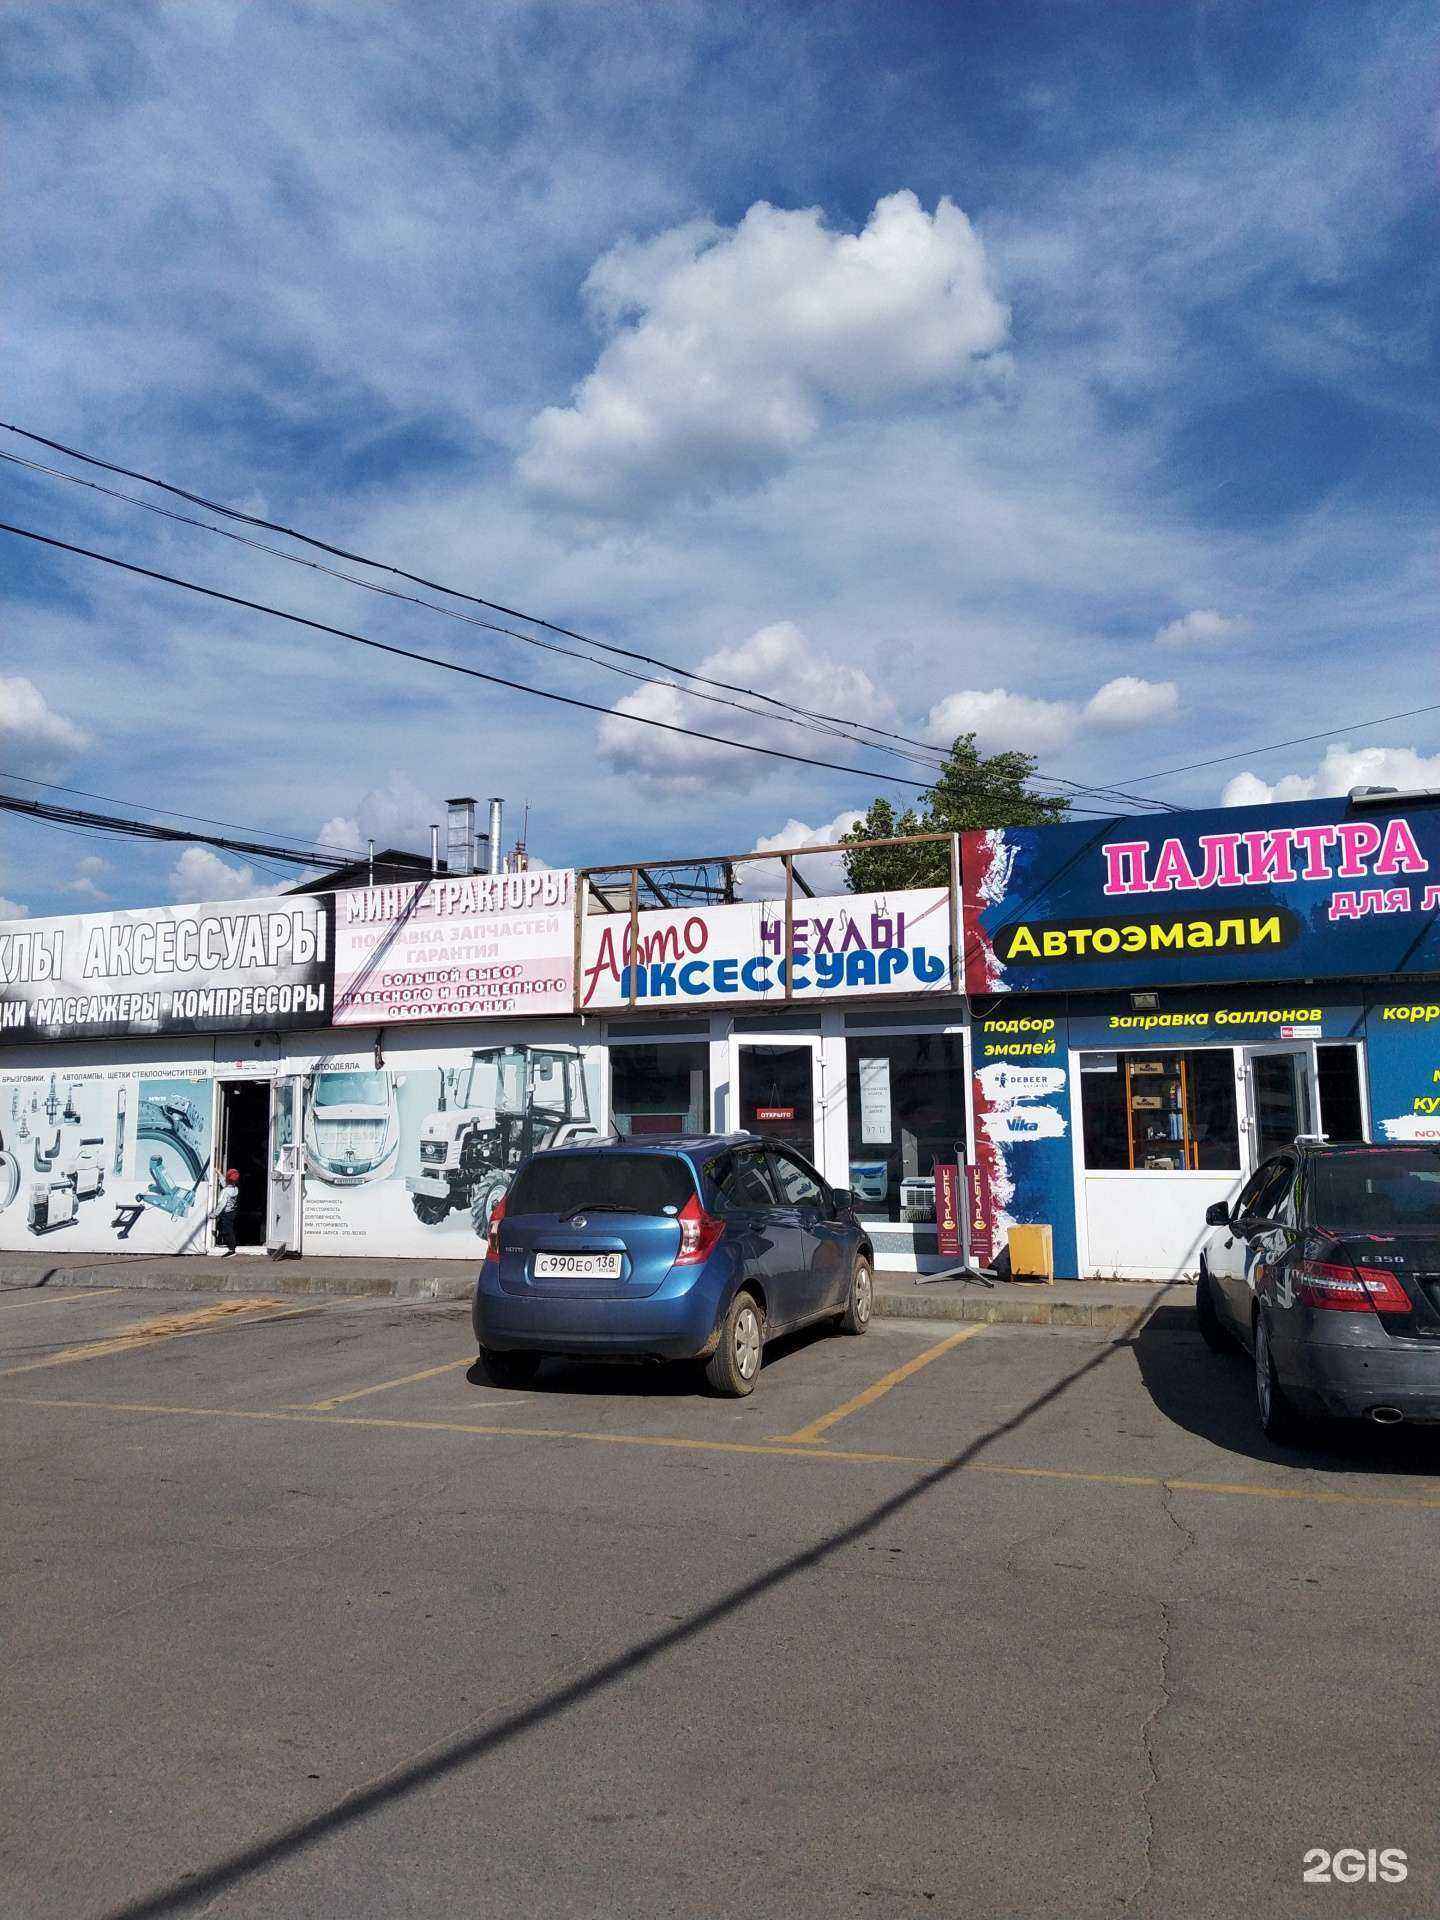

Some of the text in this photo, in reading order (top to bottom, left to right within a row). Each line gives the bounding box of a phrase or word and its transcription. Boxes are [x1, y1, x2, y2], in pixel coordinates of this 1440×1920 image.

[1103, 819, 1428, 895] ПАЛИТРА
[1328, 887, 1411, 920] для
[449, 914, 559, 940] ЗАПЧАСТЕЙ
[760, 912, 905, 956] ЧЕХЛЫ
[1007, 916, 1281, 959] Автоэмали
[82, 909, 327, 979] АКСЕССУАРЫ
[406, 944, 499, 964] ГАРАНТИЯ
[383, 965, 523, 987] БОЛЬШОЙ ВЫБОР
[438, 988, 451, 999] И
[458, 979, 567, 998] ПРИЦЕПНОГО
[0, 983, 325, 1029] КИ МАССАЖЕРЫ КОМПРЕССОРЫ
[388, 1000, 516, 1018] ОБОРУДОВАНИЯ
[1383, 1006, 1440, 1022] корр
[984, 1018, 1055, 1033] подбор
[1109, 1008, 1322, 1029] заправка баллонов
[984, 1040, 1056, 1055] эмалей
[310, 1063, 360, 1071] АВТООДЕЯЛА
[1007, 1116, 1039, 1131] Vika
[942, 1169, 952, 1220] PLASTIC
[973, 1169, 983, 1220] PLASTIC
[596, 1256, 615, 1268] 138
